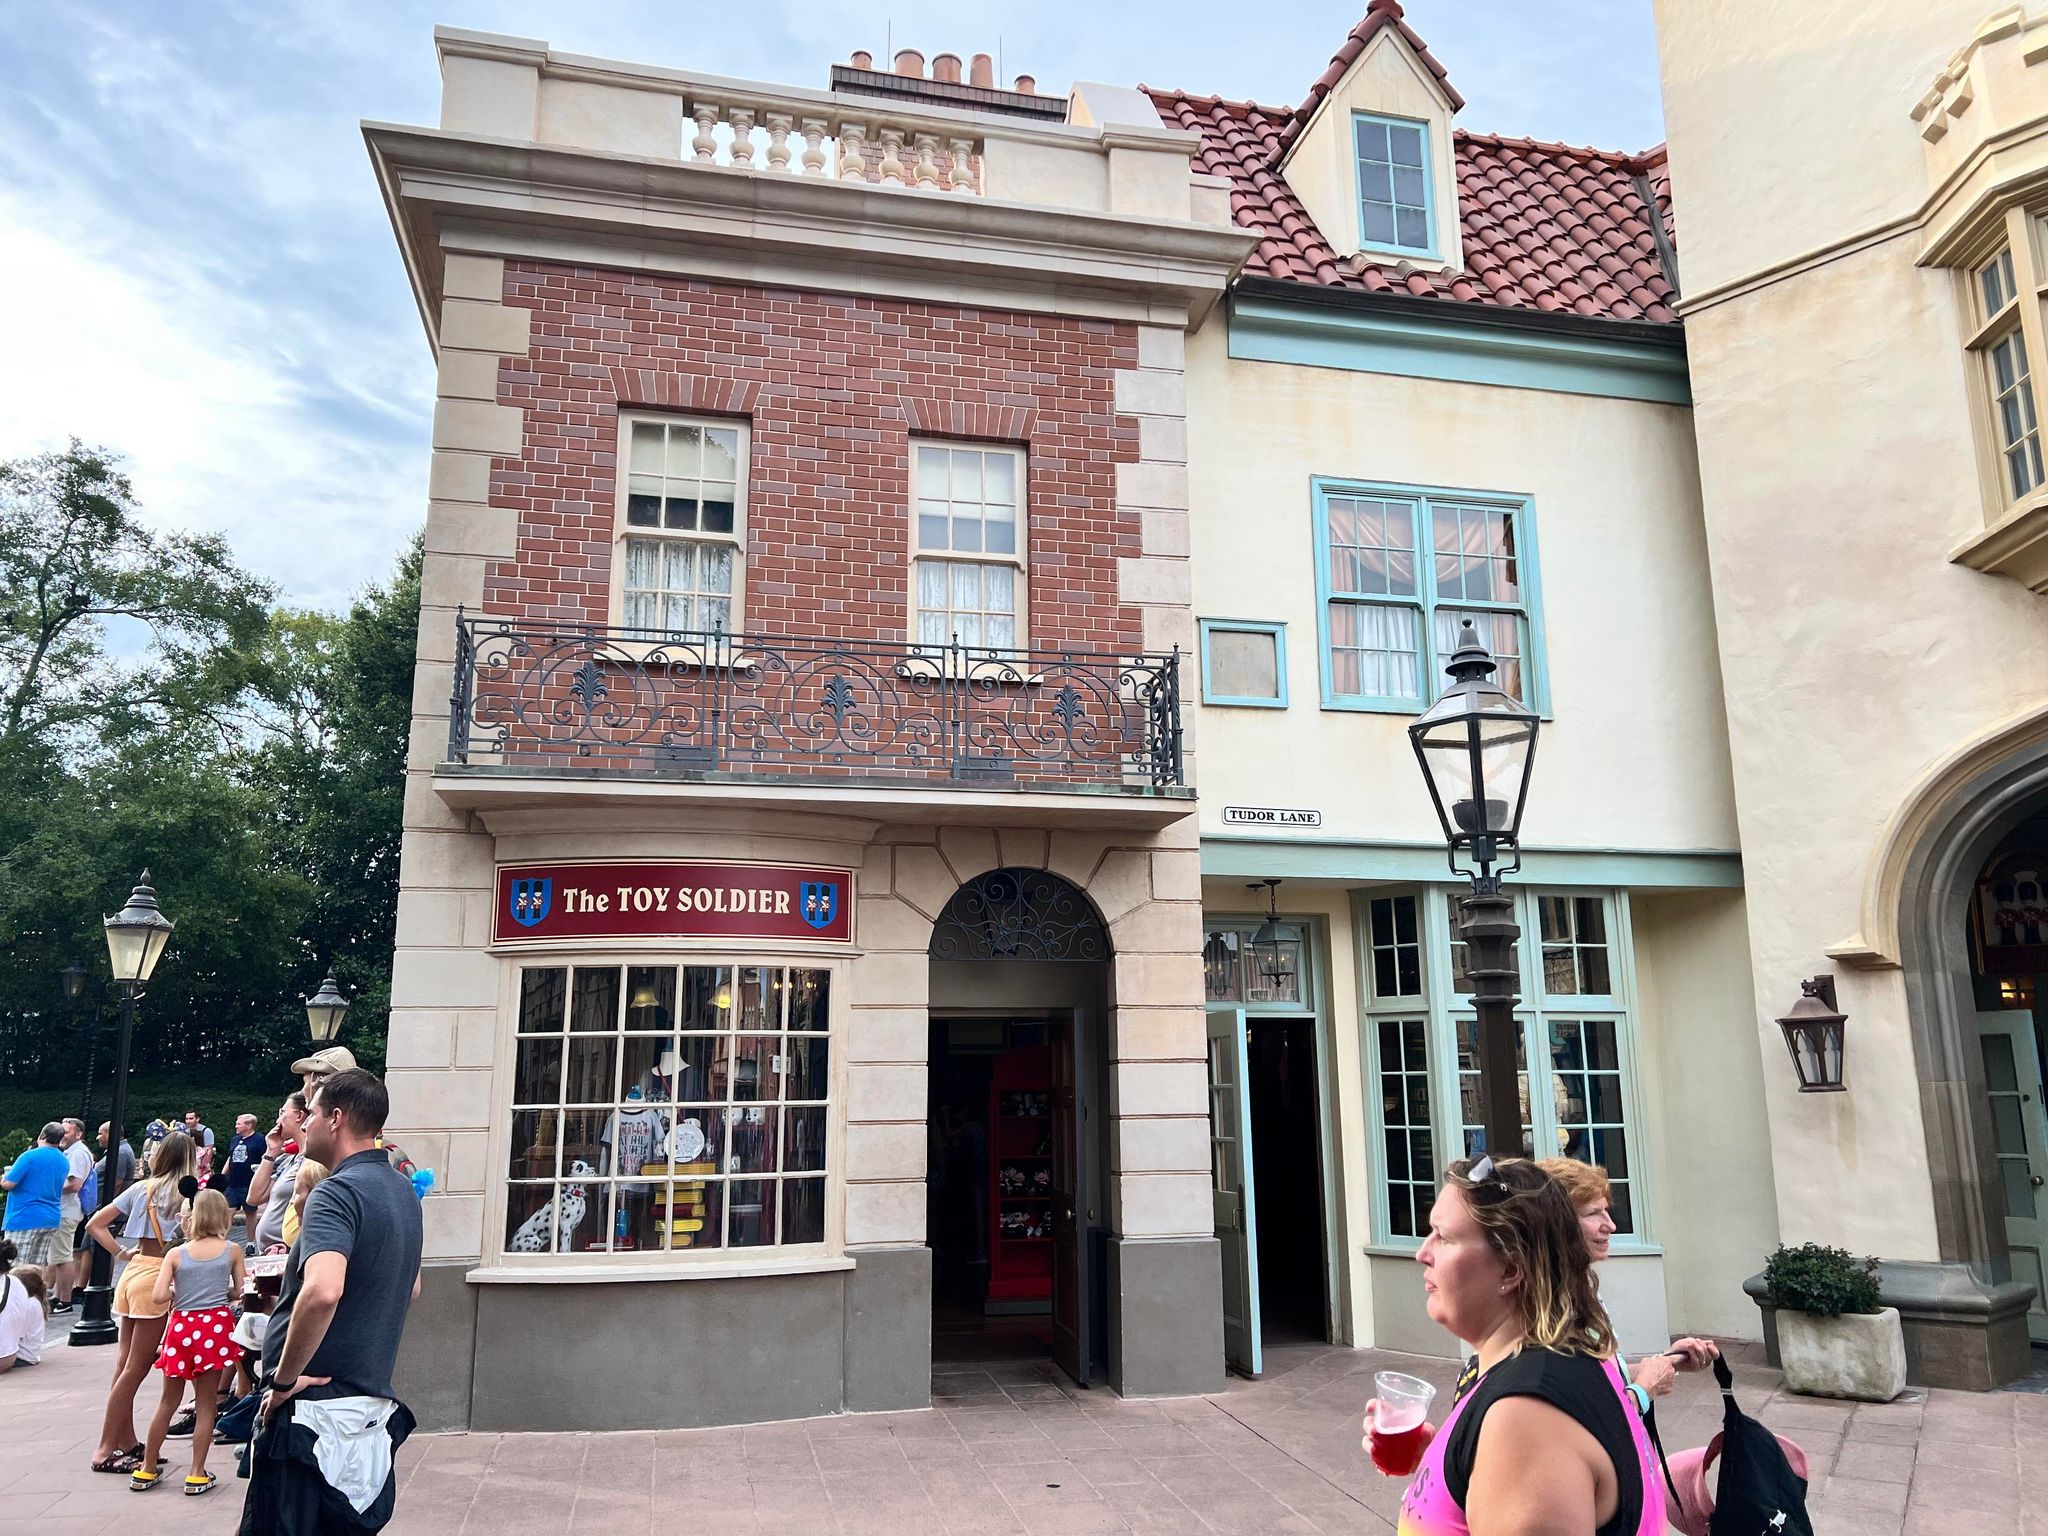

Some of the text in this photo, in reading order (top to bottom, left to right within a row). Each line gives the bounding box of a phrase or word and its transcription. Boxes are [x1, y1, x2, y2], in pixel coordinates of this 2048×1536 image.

[1229, 810, 1315, 823] TUDOR LANE
[563, 887, 790, 914] The TOY SOLDIER
